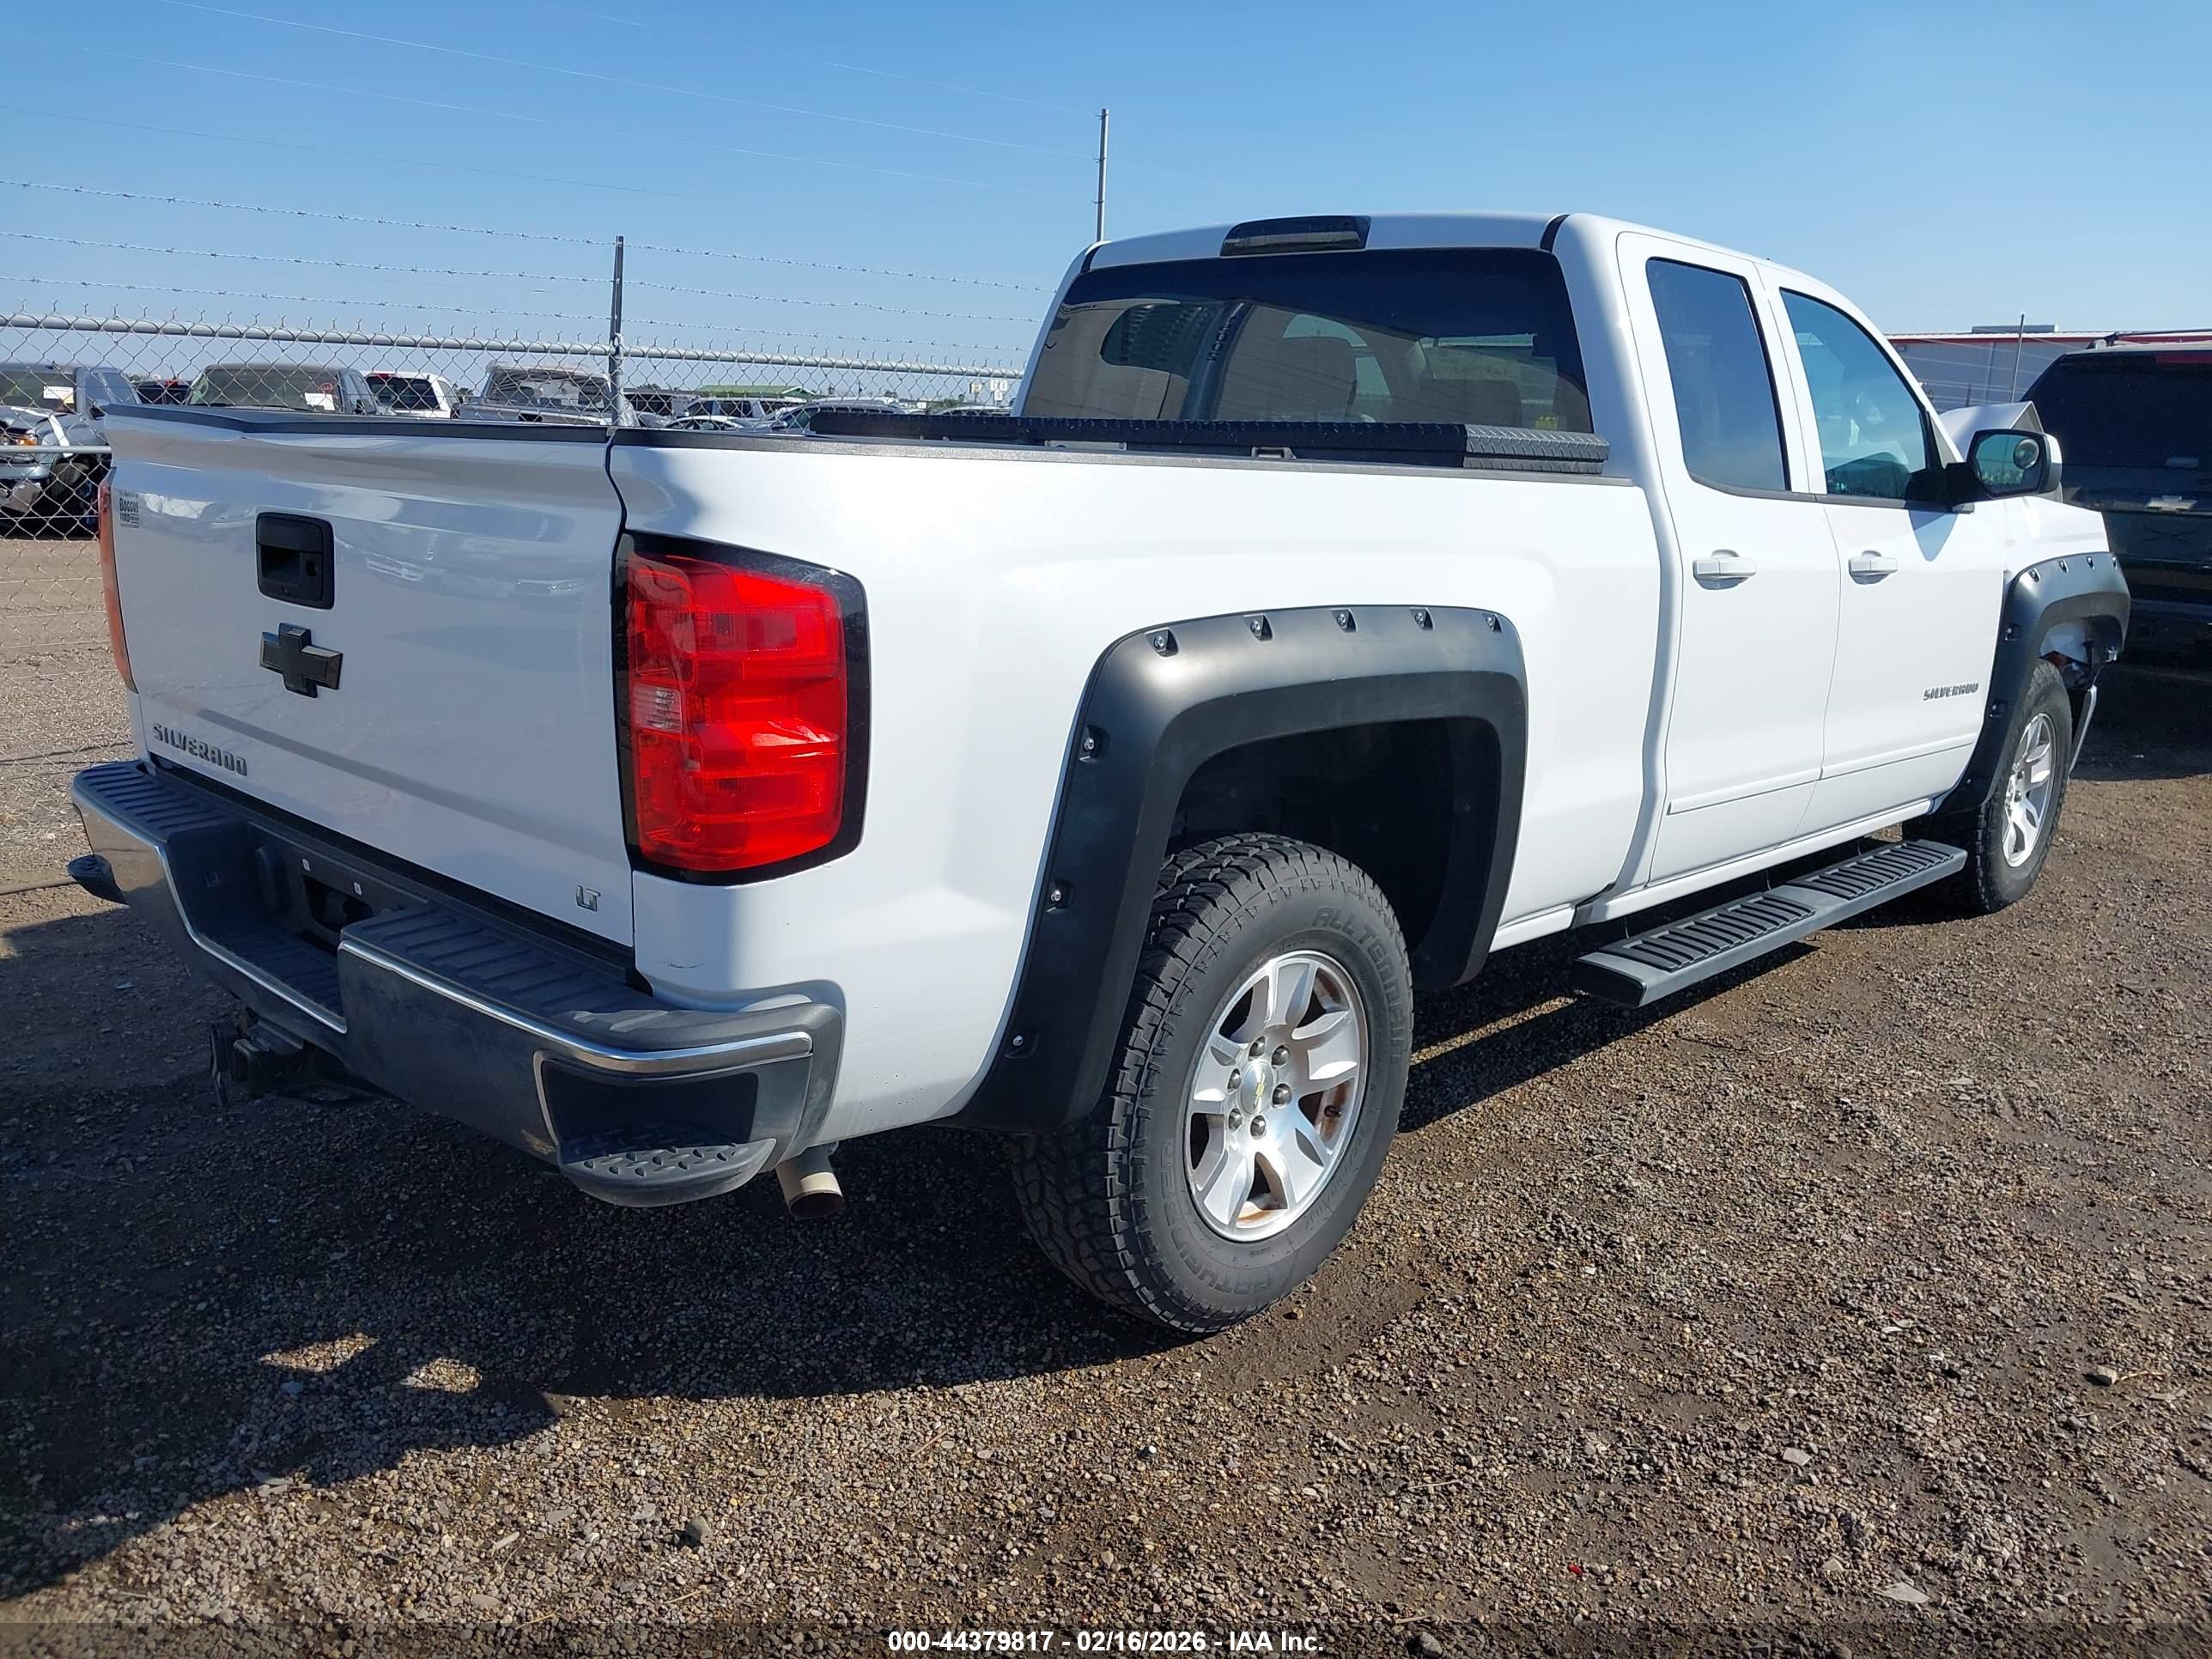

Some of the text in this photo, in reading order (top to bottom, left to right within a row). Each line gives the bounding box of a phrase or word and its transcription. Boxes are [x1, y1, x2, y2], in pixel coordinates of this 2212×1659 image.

[1923, 683, 1978, 701] SILVERADO
[153, 723, 247, 776] SILVERADO
[576, 884, 601, 912] LT
[1312, 907, 1355, 936] ALL
